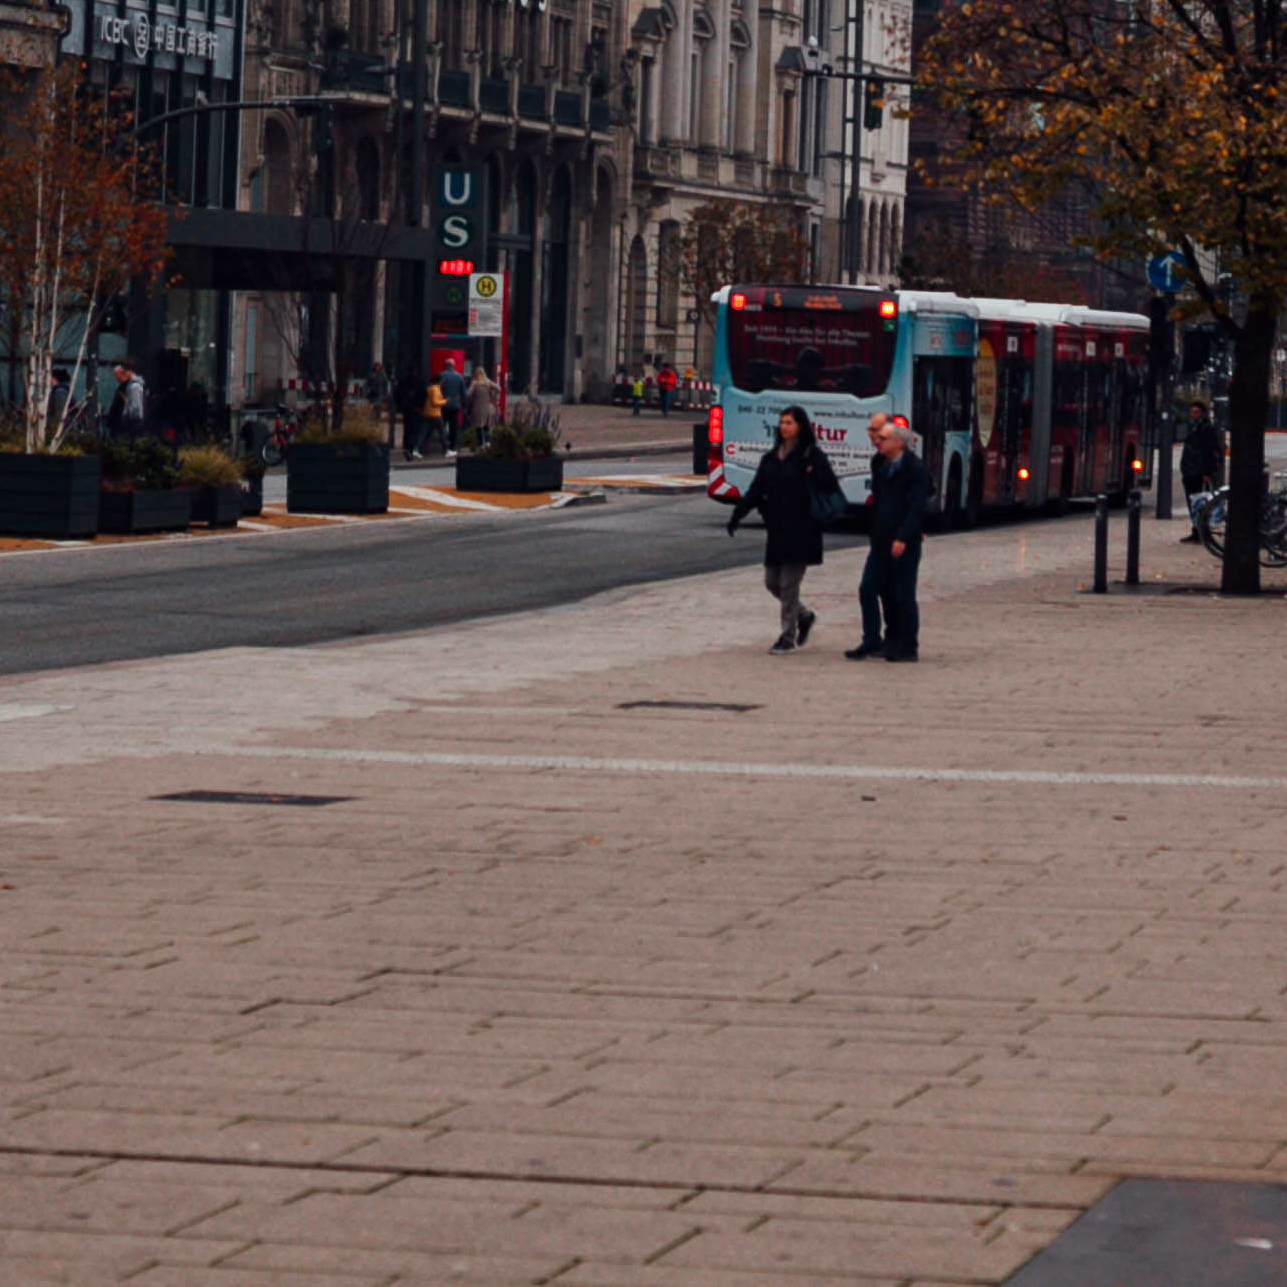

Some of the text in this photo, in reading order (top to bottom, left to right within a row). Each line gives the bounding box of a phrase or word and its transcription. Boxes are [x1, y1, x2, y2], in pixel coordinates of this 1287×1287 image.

[101, 15, 129, 45] ICBC
[444, 172, 471, 204] U
[443, 215, 469, 247] S
